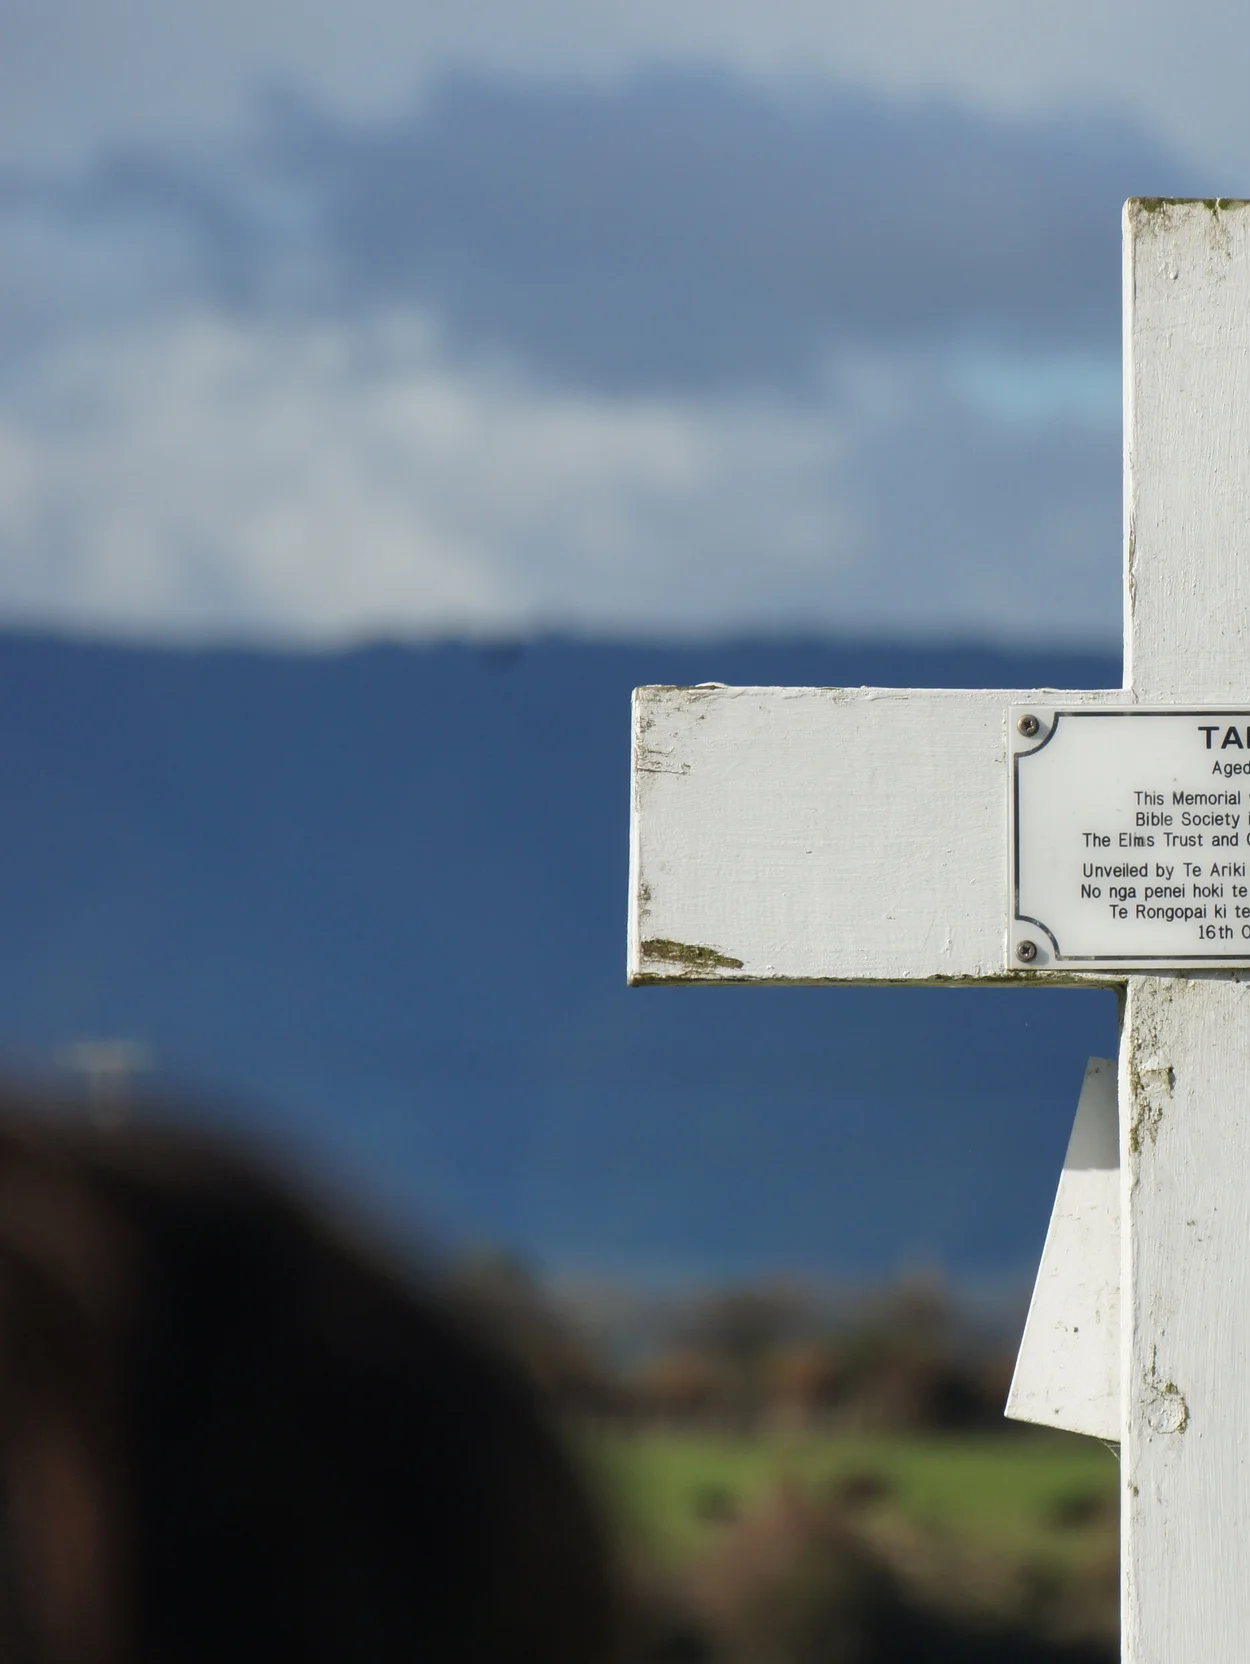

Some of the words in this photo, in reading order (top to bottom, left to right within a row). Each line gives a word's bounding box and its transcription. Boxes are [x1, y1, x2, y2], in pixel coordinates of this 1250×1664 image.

[1133, 790, 1165, 806] This
[1172, 790, 1241, 806] Memorial
[1135, 811, 1174, 827] Bible
[1181, 811, 1241, 830] Society
[1082, 832, 1111, 848] The
[1118, 832, 1155, 848] Elms
[1162, 831, 1204, 847] Trust
[1211, 831, 1239, 847] and
[1083, 862, 1149, 878] Unveiled
[1155, 862, 1175, 881] by
[1182, 862, 1202, 878] Te
[1209, 862, 1246, 877] Ariki
[1080, 883, 1102, 899] No
[1109, 886, 1137, 902] nga
[1144, 883, 1186, 902] penei
[1192, 882, 1224, 899] hoki
[1231, 884, 1248, 898] te
[1108, 904, 1129, 920] Te
[1135, 903, 1207, 923] Rongopai
[1214, 903, 1227, 919] ki
[1234, 904, 1250, 919] te
[1198, 924, 1234, 940] 16th
